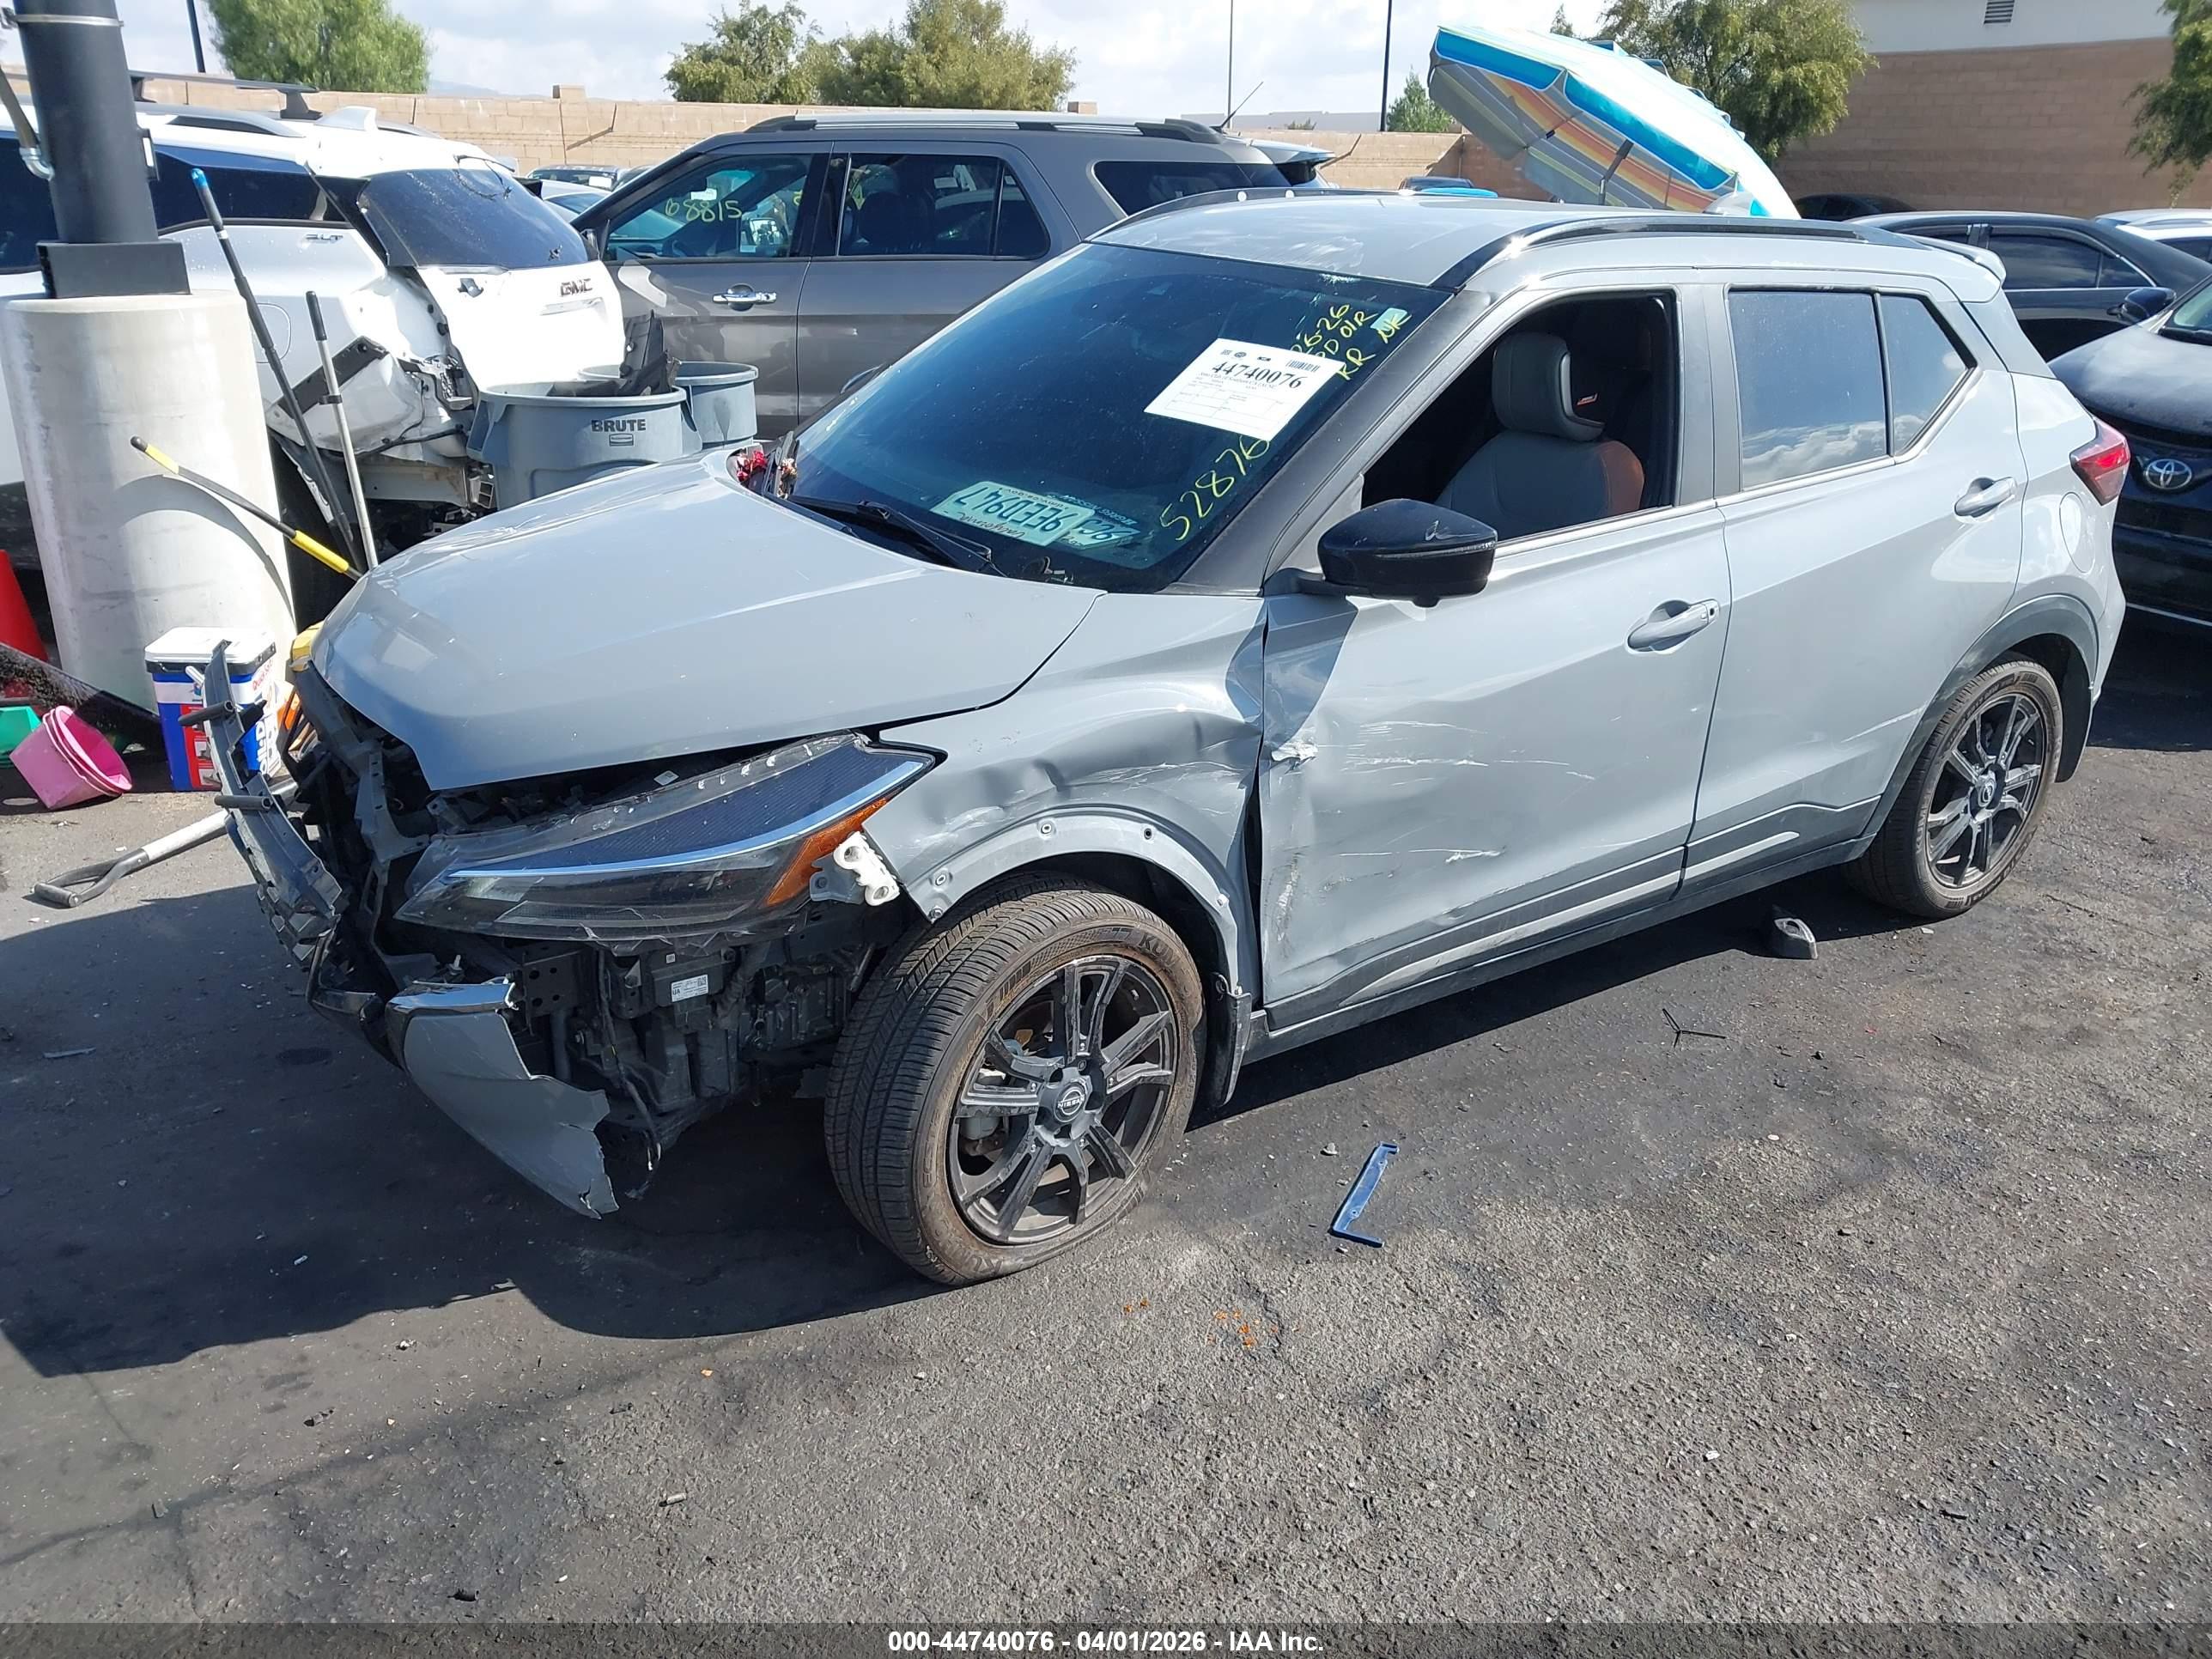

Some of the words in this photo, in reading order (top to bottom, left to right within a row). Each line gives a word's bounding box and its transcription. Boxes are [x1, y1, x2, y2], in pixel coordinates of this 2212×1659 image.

[560, 277, 593, 296] GMC
[1212, 361, 1308, 389] 44740076
[591, 419, 647, 433] BRUTE
[1160, 435, 1270, 541] 52876
[954, 486, 1079, 532] 9EED947
[1057, 1094, 1085, 1109] NISSAN
